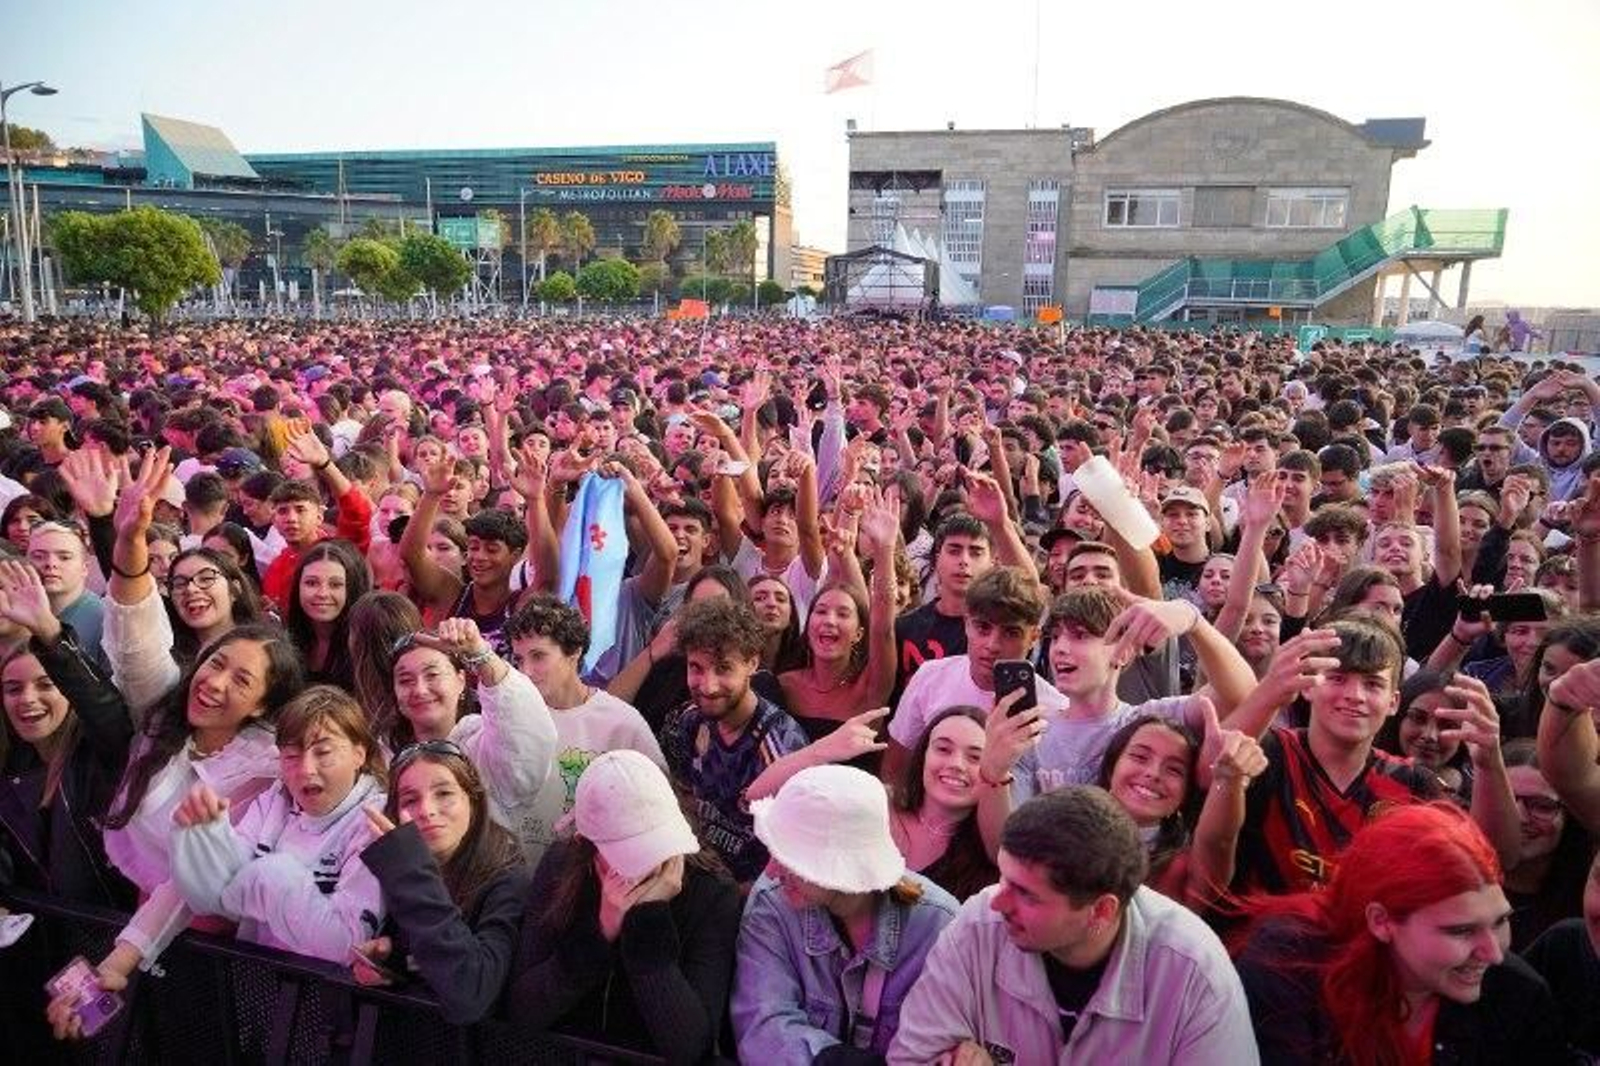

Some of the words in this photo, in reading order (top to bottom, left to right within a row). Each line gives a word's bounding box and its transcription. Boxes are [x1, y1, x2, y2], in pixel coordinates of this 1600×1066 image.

[703, 154, 718, 177] A
[536, 172, 584, 185] CASINO
[611, 170, 645, 183] VIGO
[559, 188, 651, 201] METROPOLITAN
[706, 825, 744, 854] BETTER
